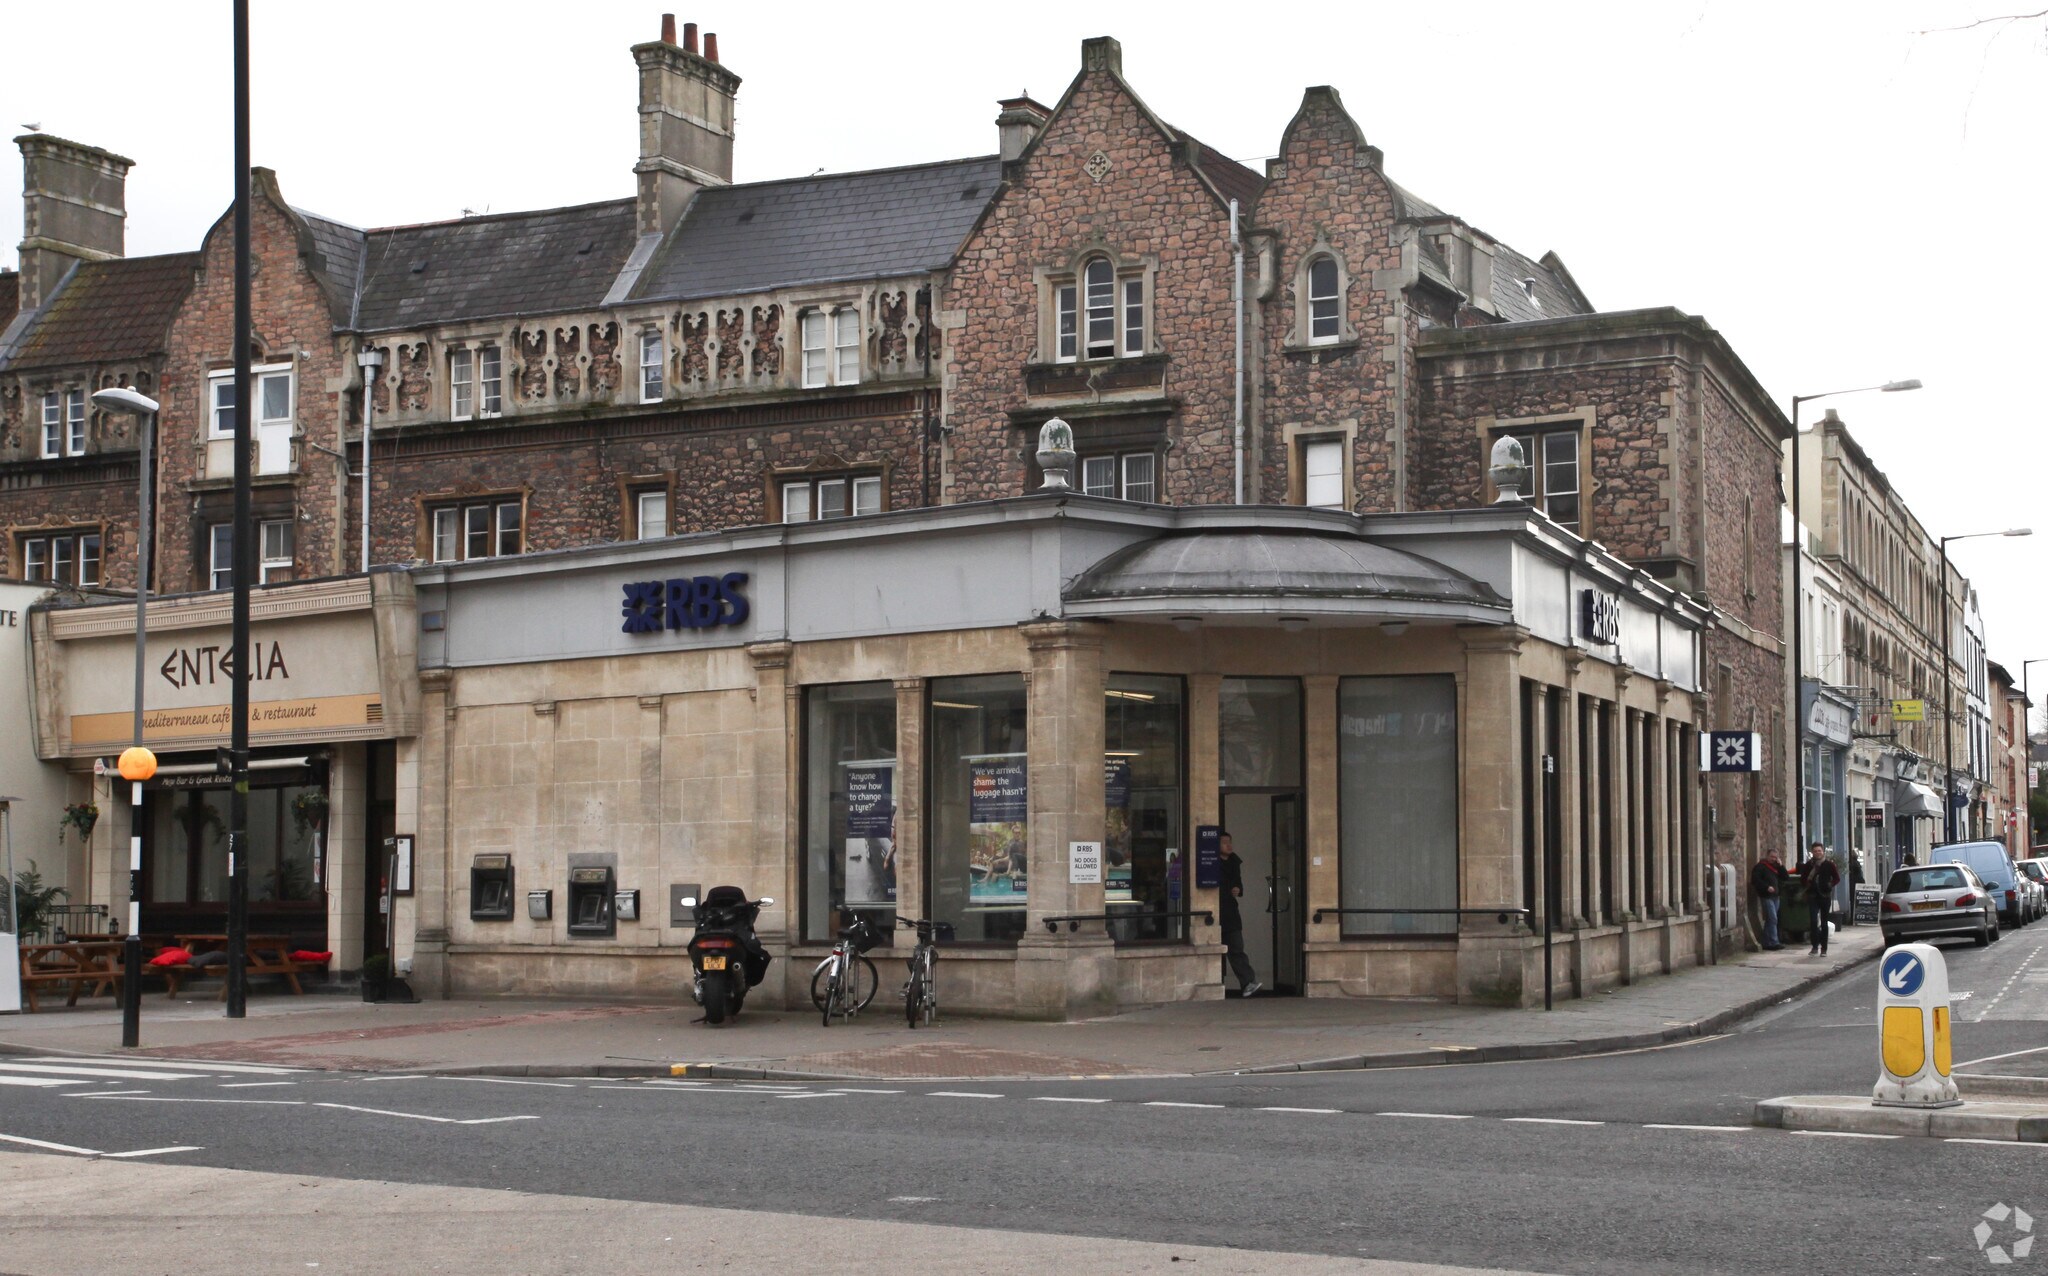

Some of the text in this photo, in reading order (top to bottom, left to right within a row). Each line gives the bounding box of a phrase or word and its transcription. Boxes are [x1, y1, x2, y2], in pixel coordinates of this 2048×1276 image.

[666, 572, 749, 629] RBS
[0, 610, 17, 627] TE
[1603, 594, 1620, 646] RBS
[161, 641, 289, 689] ENTEIA
[211, 707, 230, 732] café
[252, 709, 261, 721] &
[264, 703, 317, 720] restaurant
[996, 765, 1022, 775] arrived,
[850, 782, 882, 790] know how
[973, 777, 1010, 787] shame the
[858, 793, 881, 802] change
[973, 789, 1000, 799] luggage
